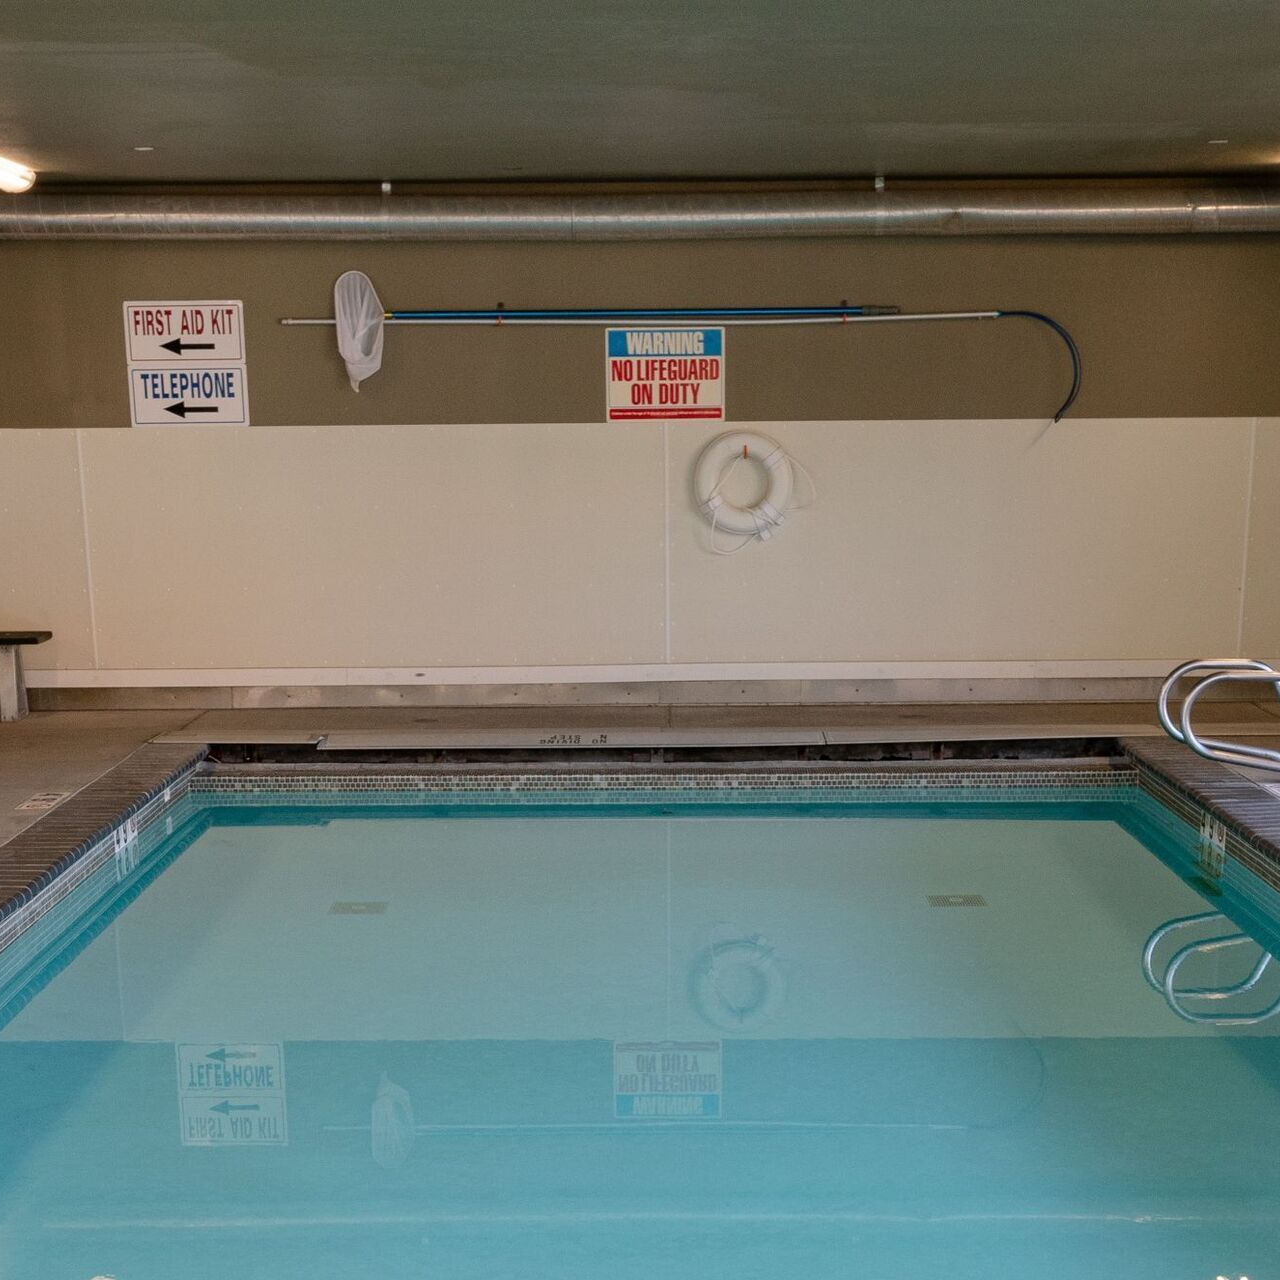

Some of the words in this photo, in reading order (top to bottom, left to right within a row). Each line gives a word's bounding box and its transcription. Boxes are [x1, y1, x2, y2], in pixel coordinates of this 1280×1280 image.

[133, 309, 172, 336] FIRST
[180, 309, 205, 335] AID
[210, 308, 233, 335] KIT
[625, 331, 705, 355] WARNING
[611, 359, 633, 381] NO
[636, 358, 720, 381] LIFEGUARD
[140, 372, 235, 399] TELEPHONE
[631, 383, 653, 405] ON
[658, 383, 701, 405] DUTY
